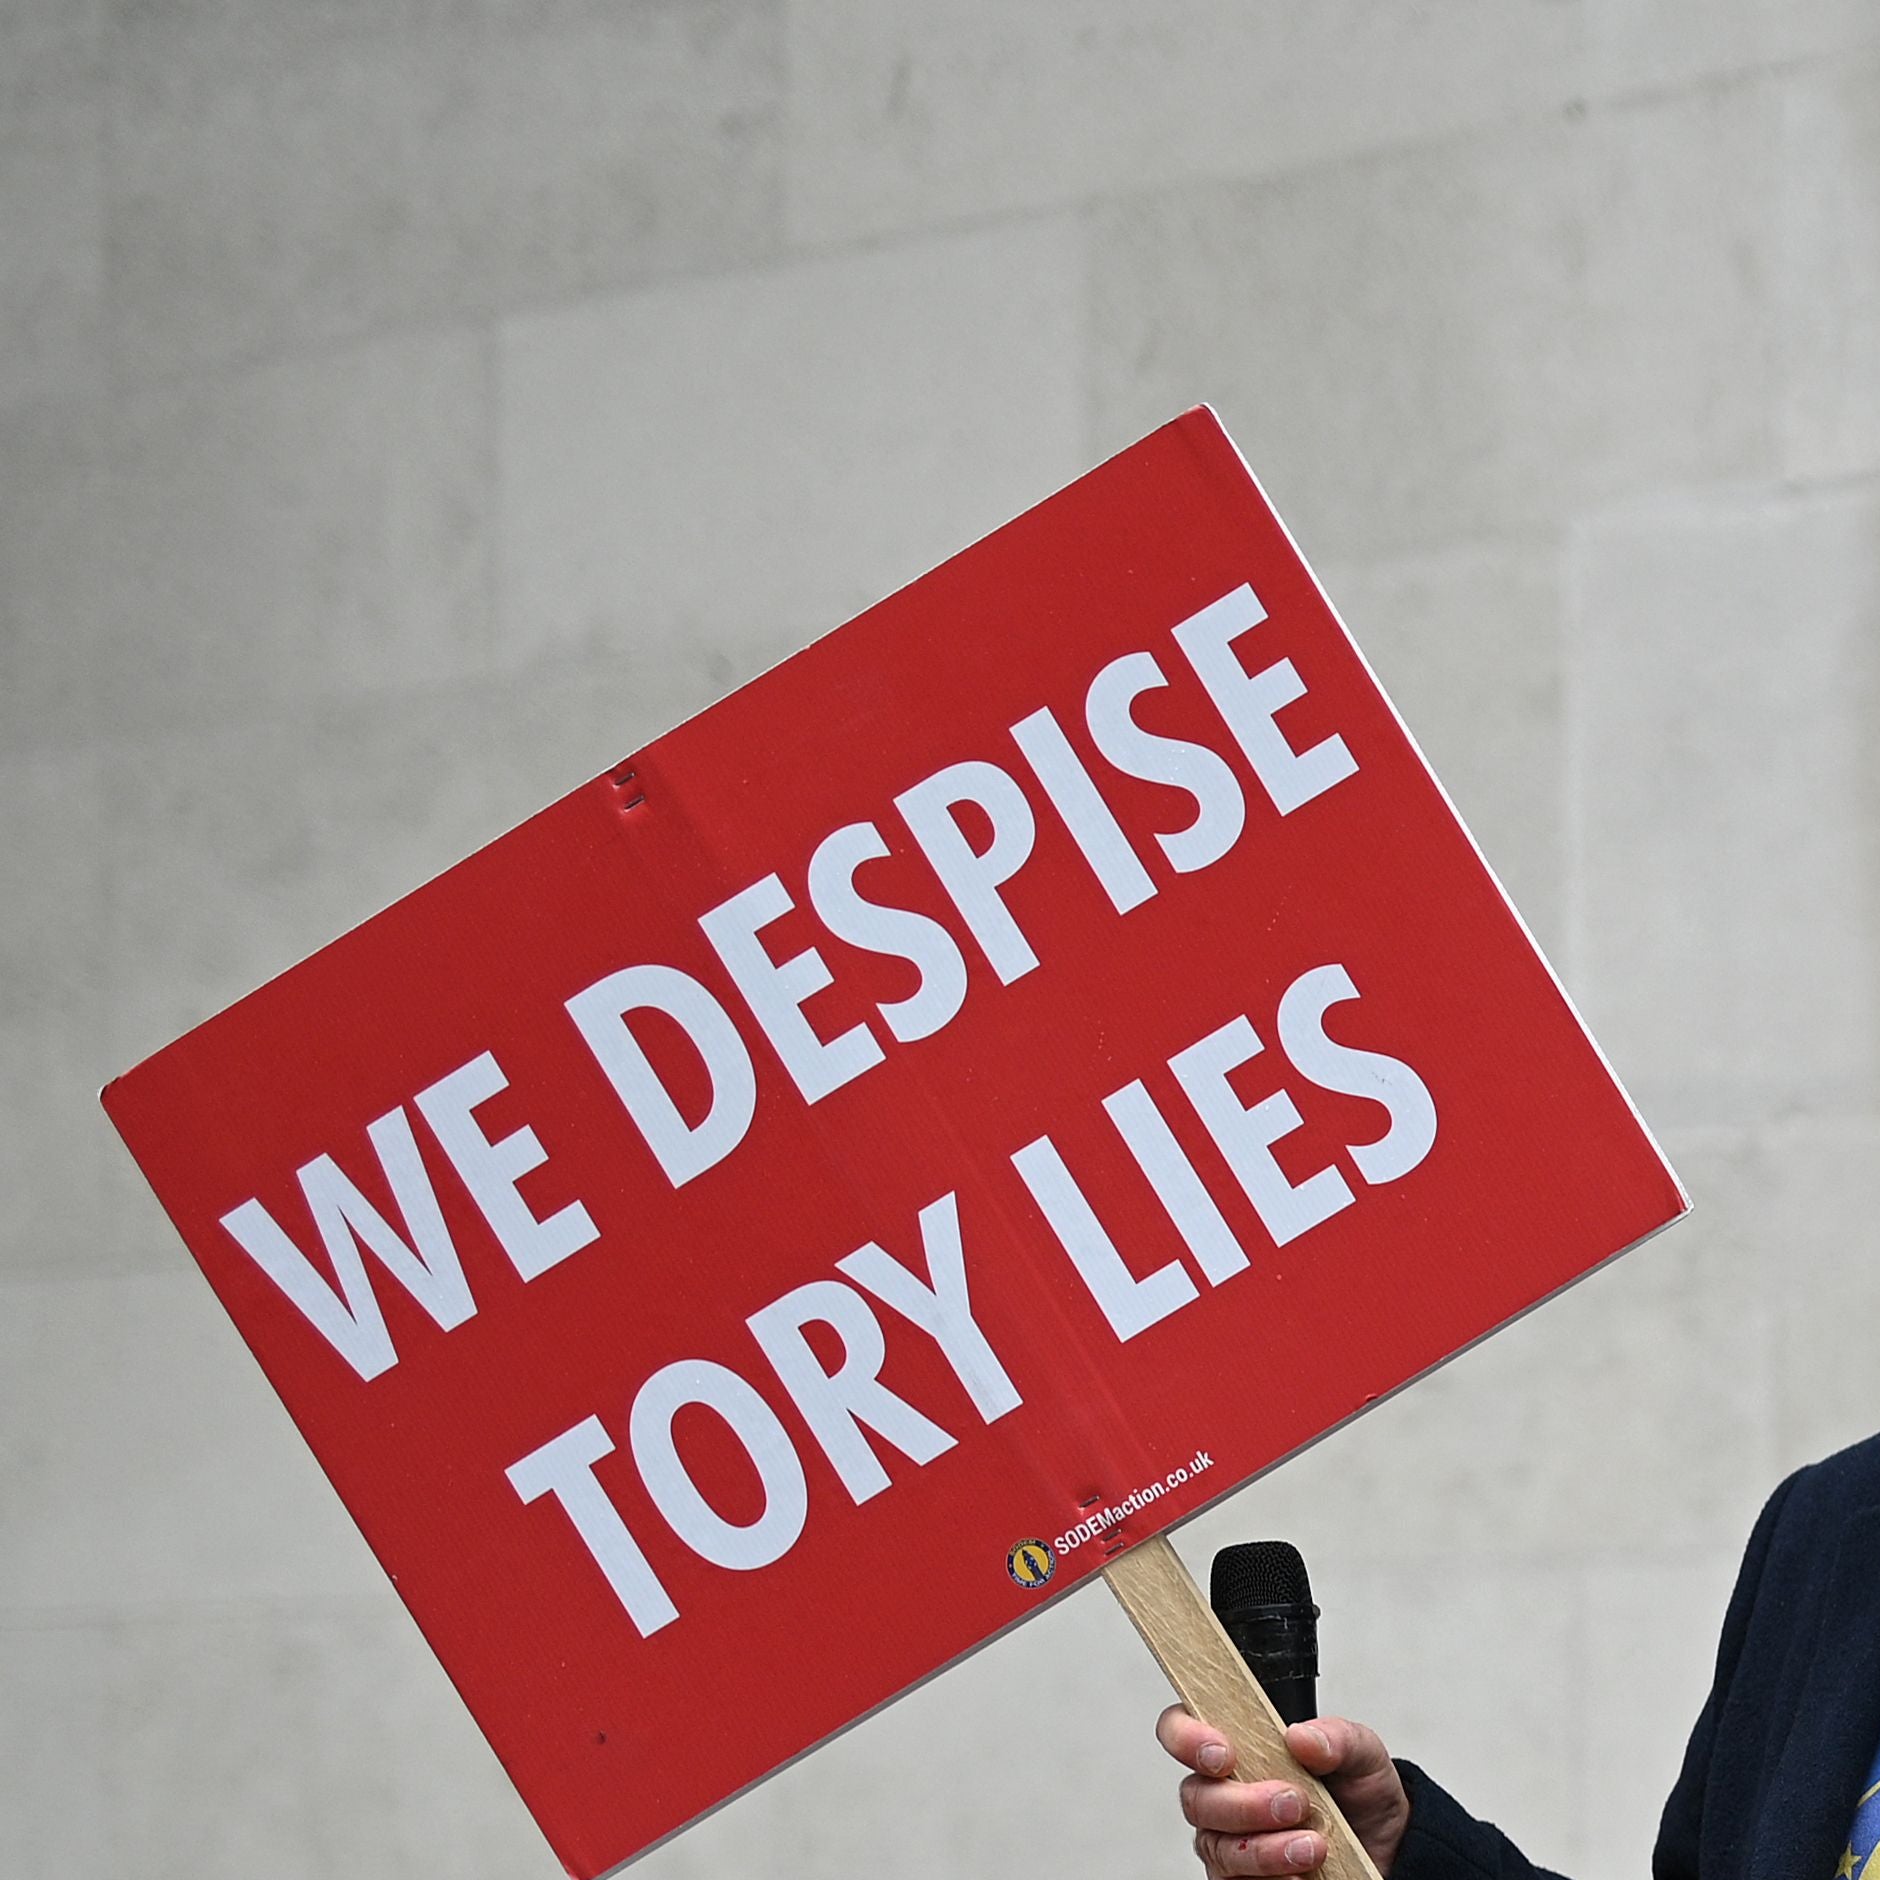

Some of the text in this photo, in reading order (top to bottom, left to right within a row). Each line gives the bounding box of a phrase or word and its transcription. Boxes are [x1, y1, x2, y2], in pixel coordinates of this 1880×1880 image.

[219, 582, 1360, 1383] WE DESPISE
[504, 963, 1438, 1639] TORY LIES
[1054, 1450, 1215, 1556] SODEMaction.co.uk
